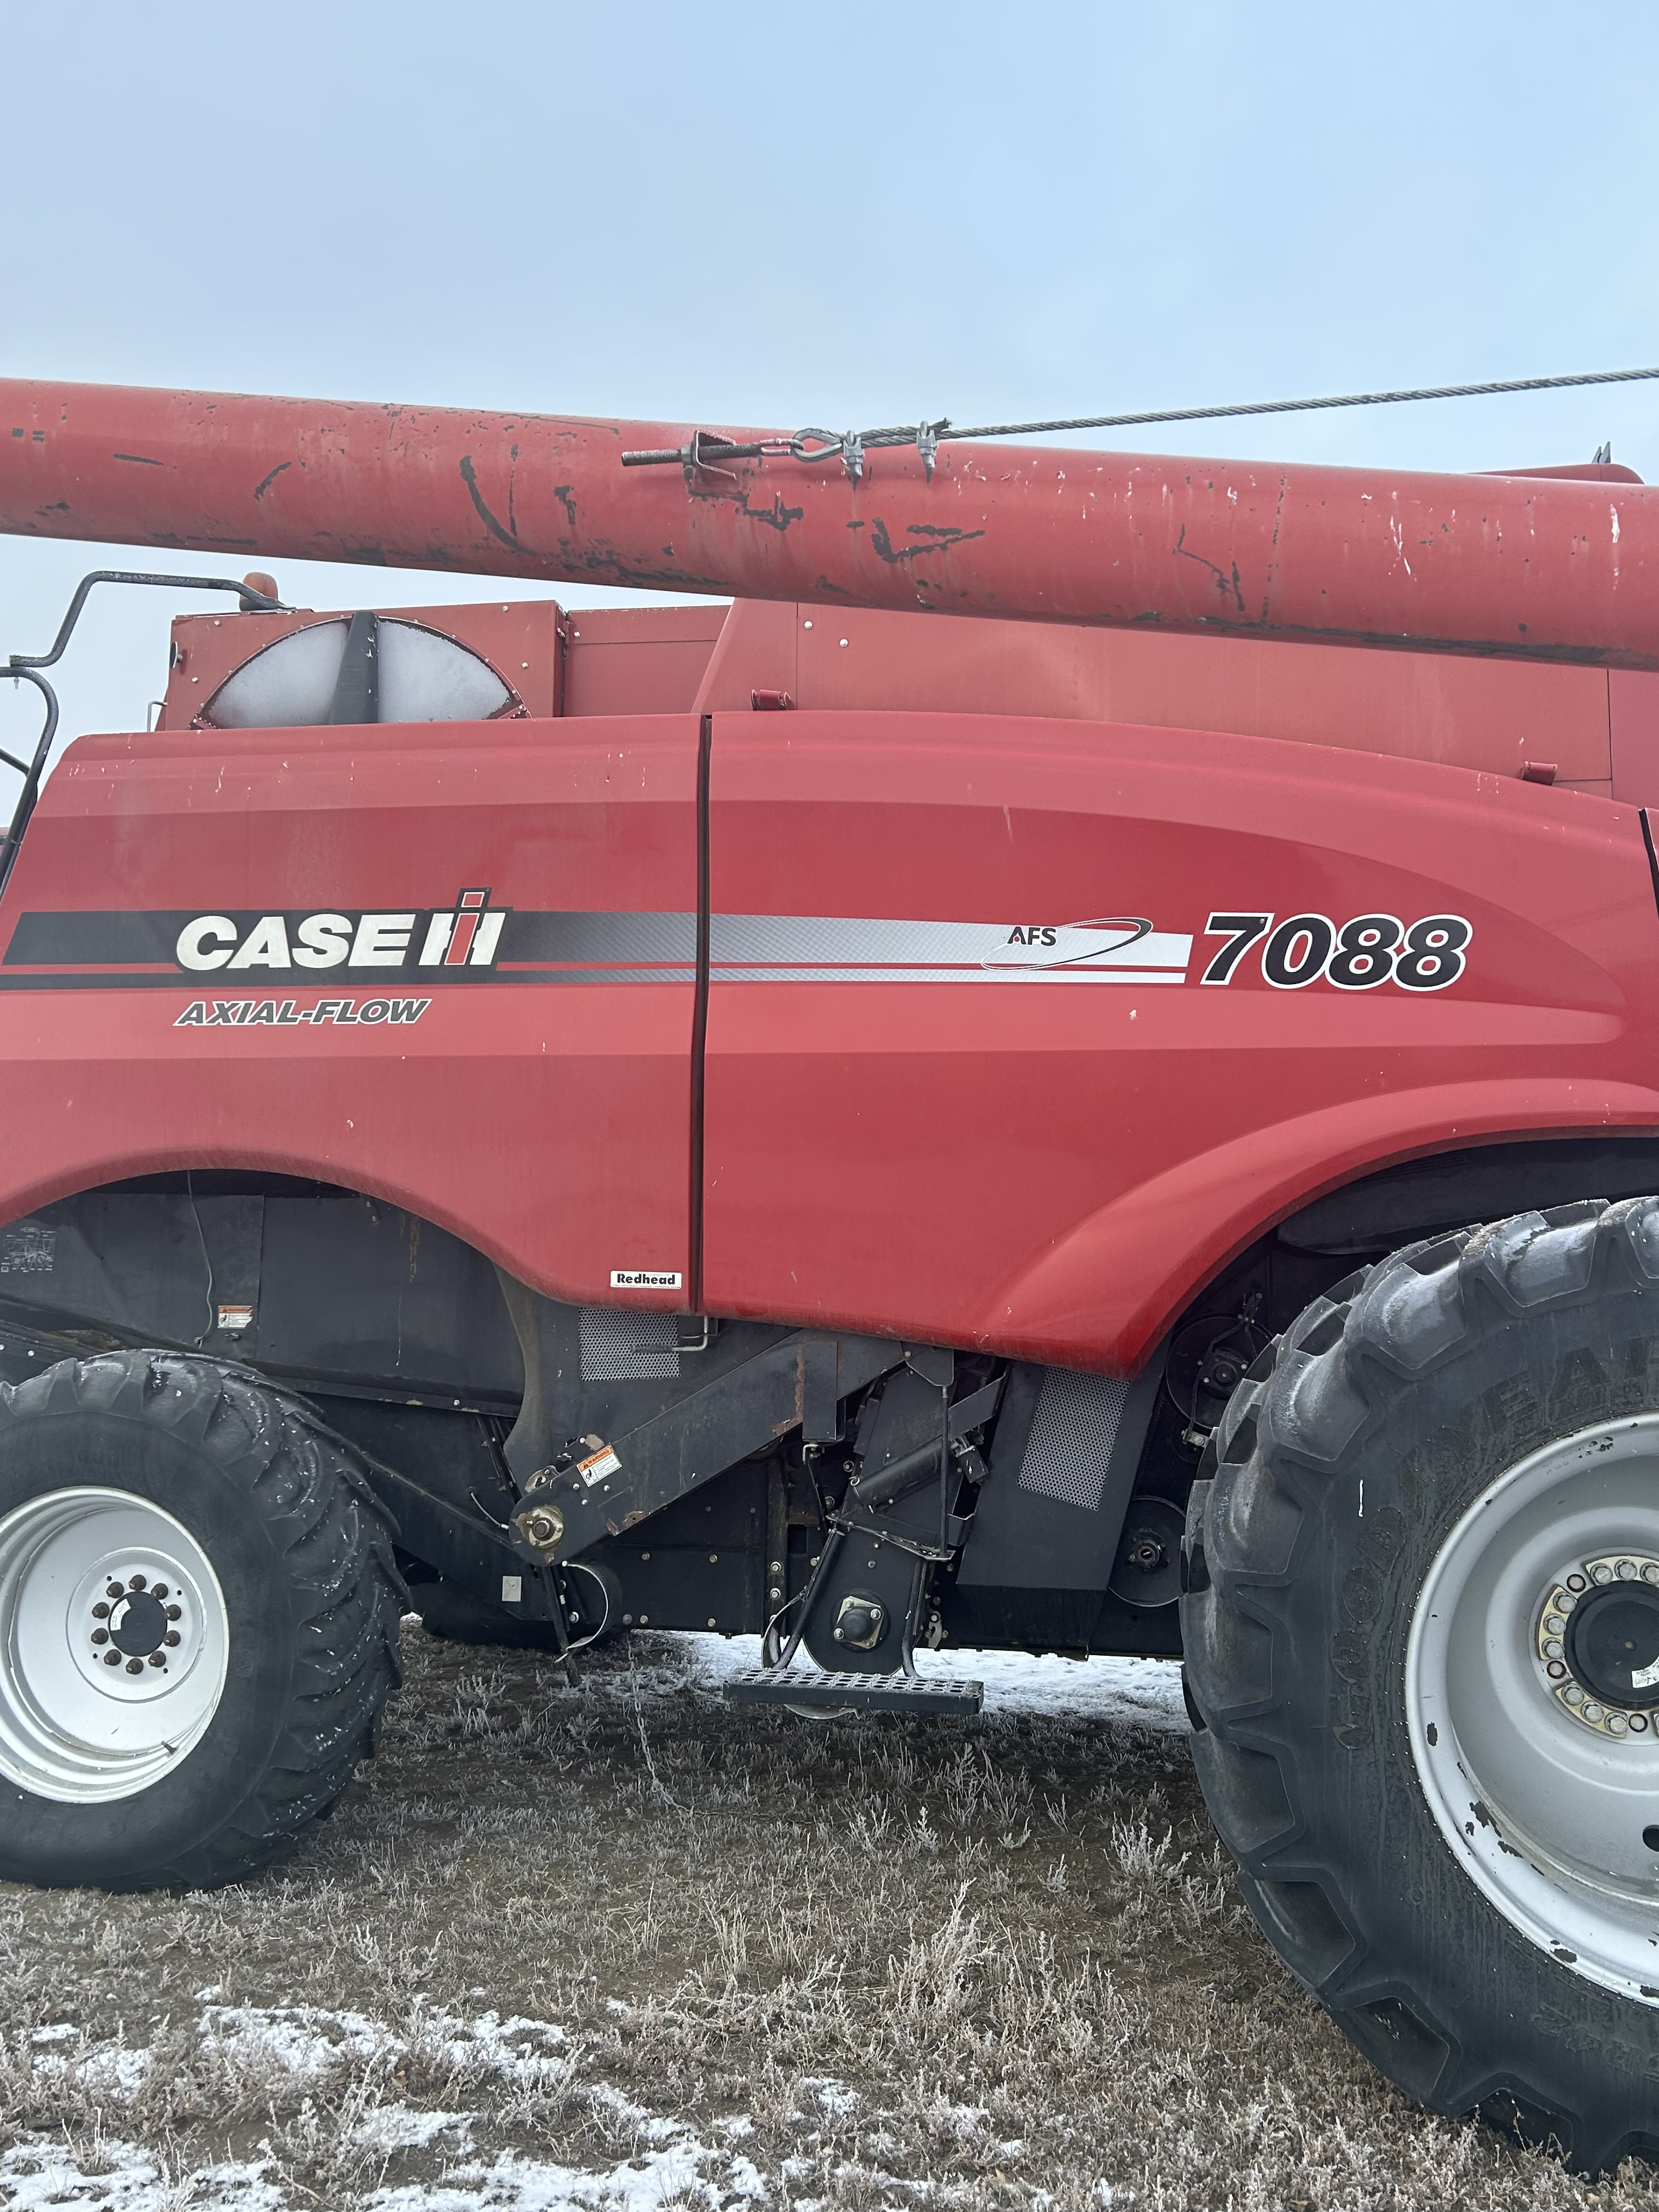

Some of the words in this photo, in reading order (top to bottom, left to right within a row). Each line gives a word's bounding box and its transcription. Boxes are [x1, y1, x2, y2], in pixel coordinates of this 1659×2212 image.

[176, 913, 416, 970] CASE
[1007, 926, 1057, 946] AFS
[1199, 911, 1473, 992] 7088
[173, 998, 432, 1026] AXIAL-FLOW
[617, 1273, 675, 1285] Redhead
[588, 1449, 610, 1464] WARNING
